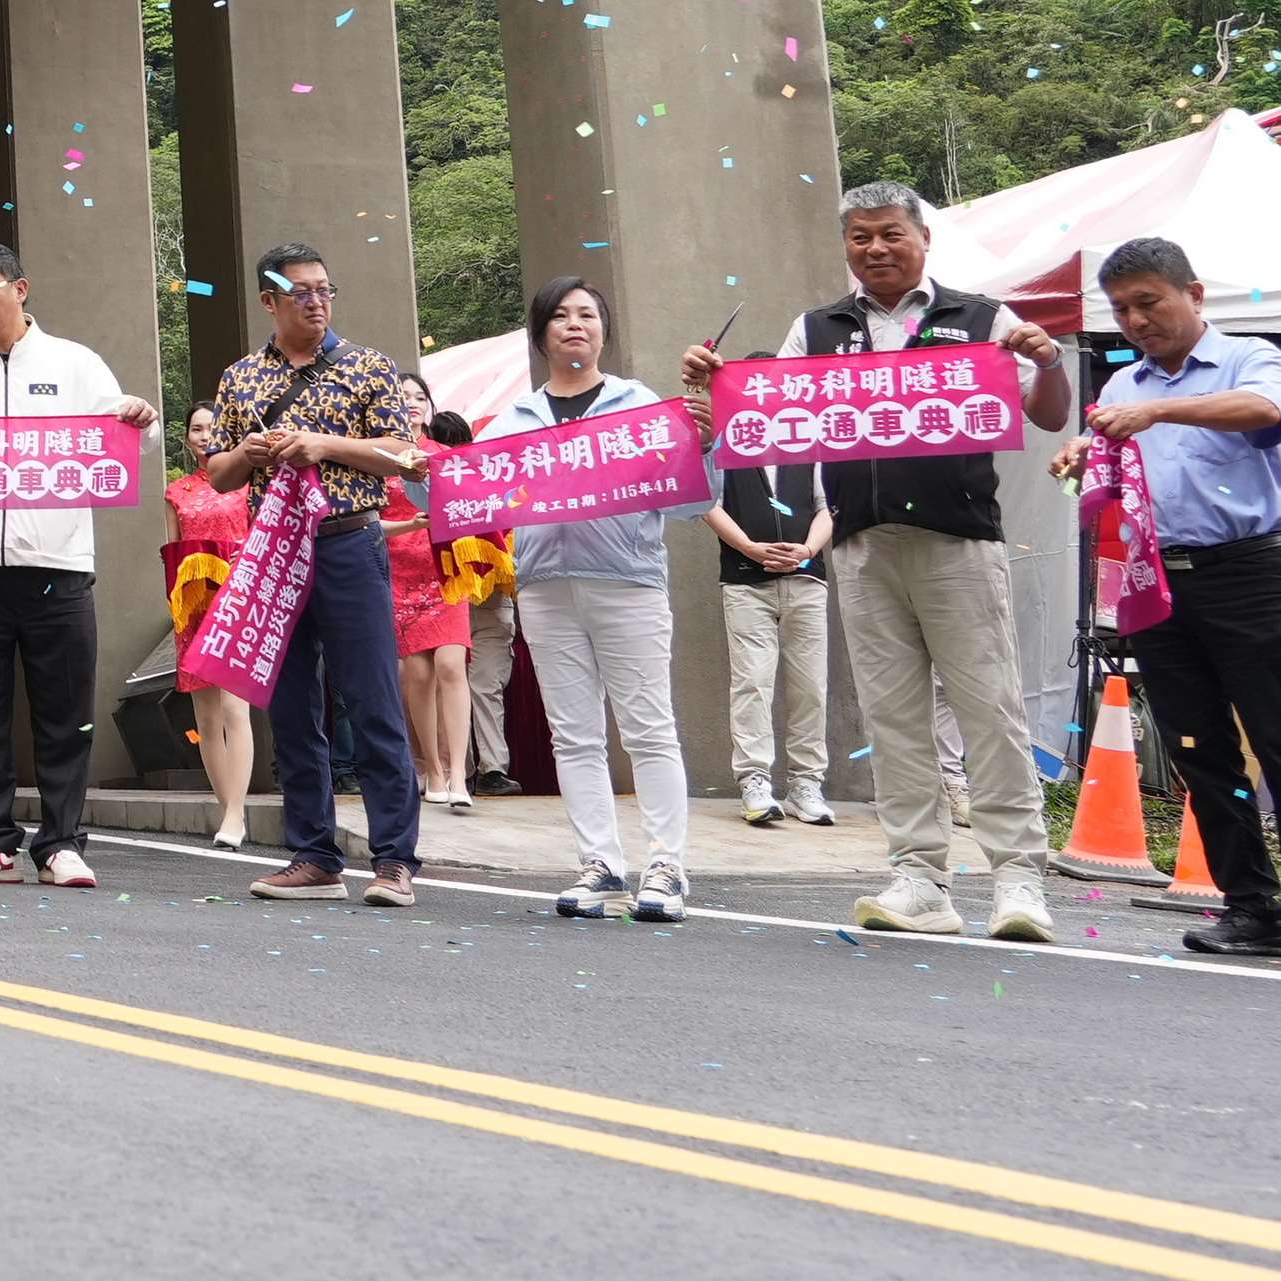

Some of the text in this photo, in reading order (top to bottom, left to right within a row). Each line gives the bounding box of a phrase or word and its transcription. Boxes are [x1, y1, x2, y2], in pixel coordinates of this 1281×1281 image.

[742, 358, 980, 406] 牛奶科明隧道
[438, 415, 677, 486] 牛奶科明隧道
[731, 400, 1004, 450] 竣工通車典禮
[200, 460, 297, 659] 古坑鄉草嶺村
